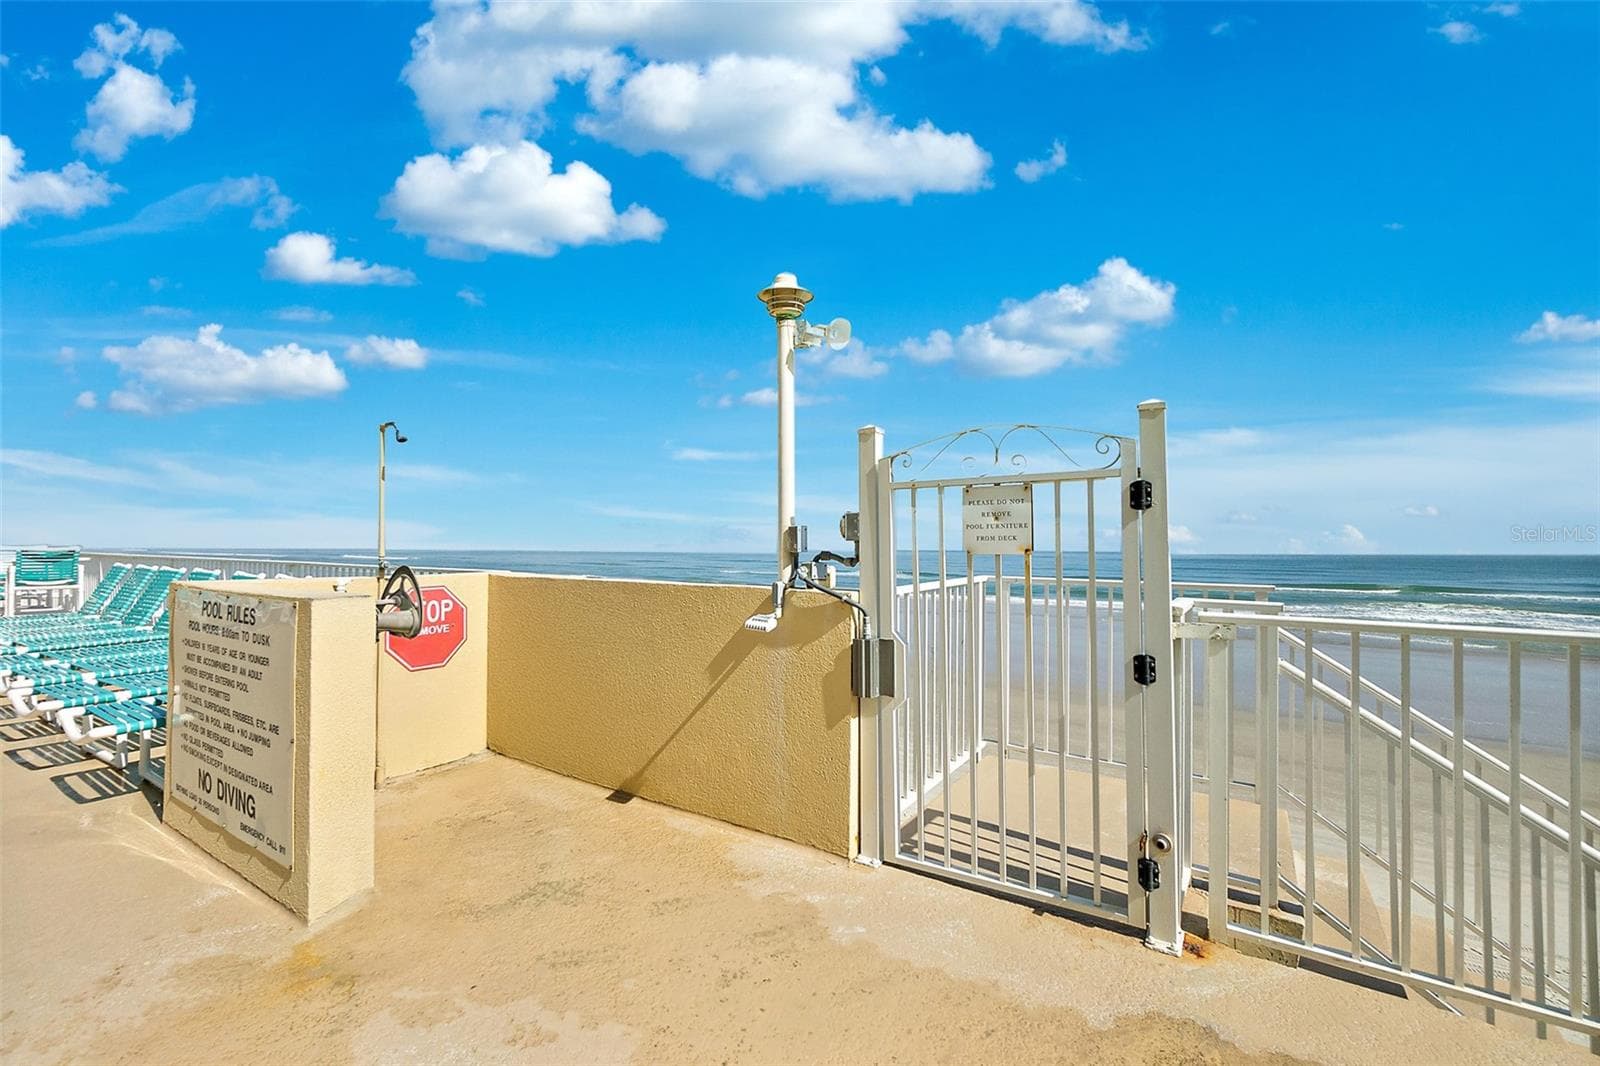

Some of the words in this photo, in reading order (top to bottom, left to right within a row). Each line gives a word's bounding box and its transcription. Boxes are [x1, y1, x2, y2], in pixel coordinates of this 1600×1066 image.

[986, 522, 1029, 530] FURNITURE
[202, 600, 222, 619] POOL
[227, 604, 256, 626] RULES
[188, 620, 201, 632] POOL
[242, 630, 250, 643] TO
[252, 633, 271, 647] DUSK
[221, 647, 228, 655] OF
[229, 649, 238, 659] AGE
[239, 651, 246, 661] OR
[248, 653, 270, 667] YOUNGER
[248, 669, 263, 681] ADULT
[236, 681, 249, 694] POOL
[210, 716, 222, 729] POOL
[223, 722, 235, 734] AREA
[241, 728, 248, 739] NO
[249, 731, 271, 749] JUMPING
[268, 724, 280, 736] ARE
[232, 740, 254, 757] ALLOWED
[228, 765, 259, 788] DESIGNATED
[259, 780, 273, 795] AREA
[198, 768, 212, 794] NO
[217, 777, 256, 820] DIVING
[266, 836, 278, 851] CALL
